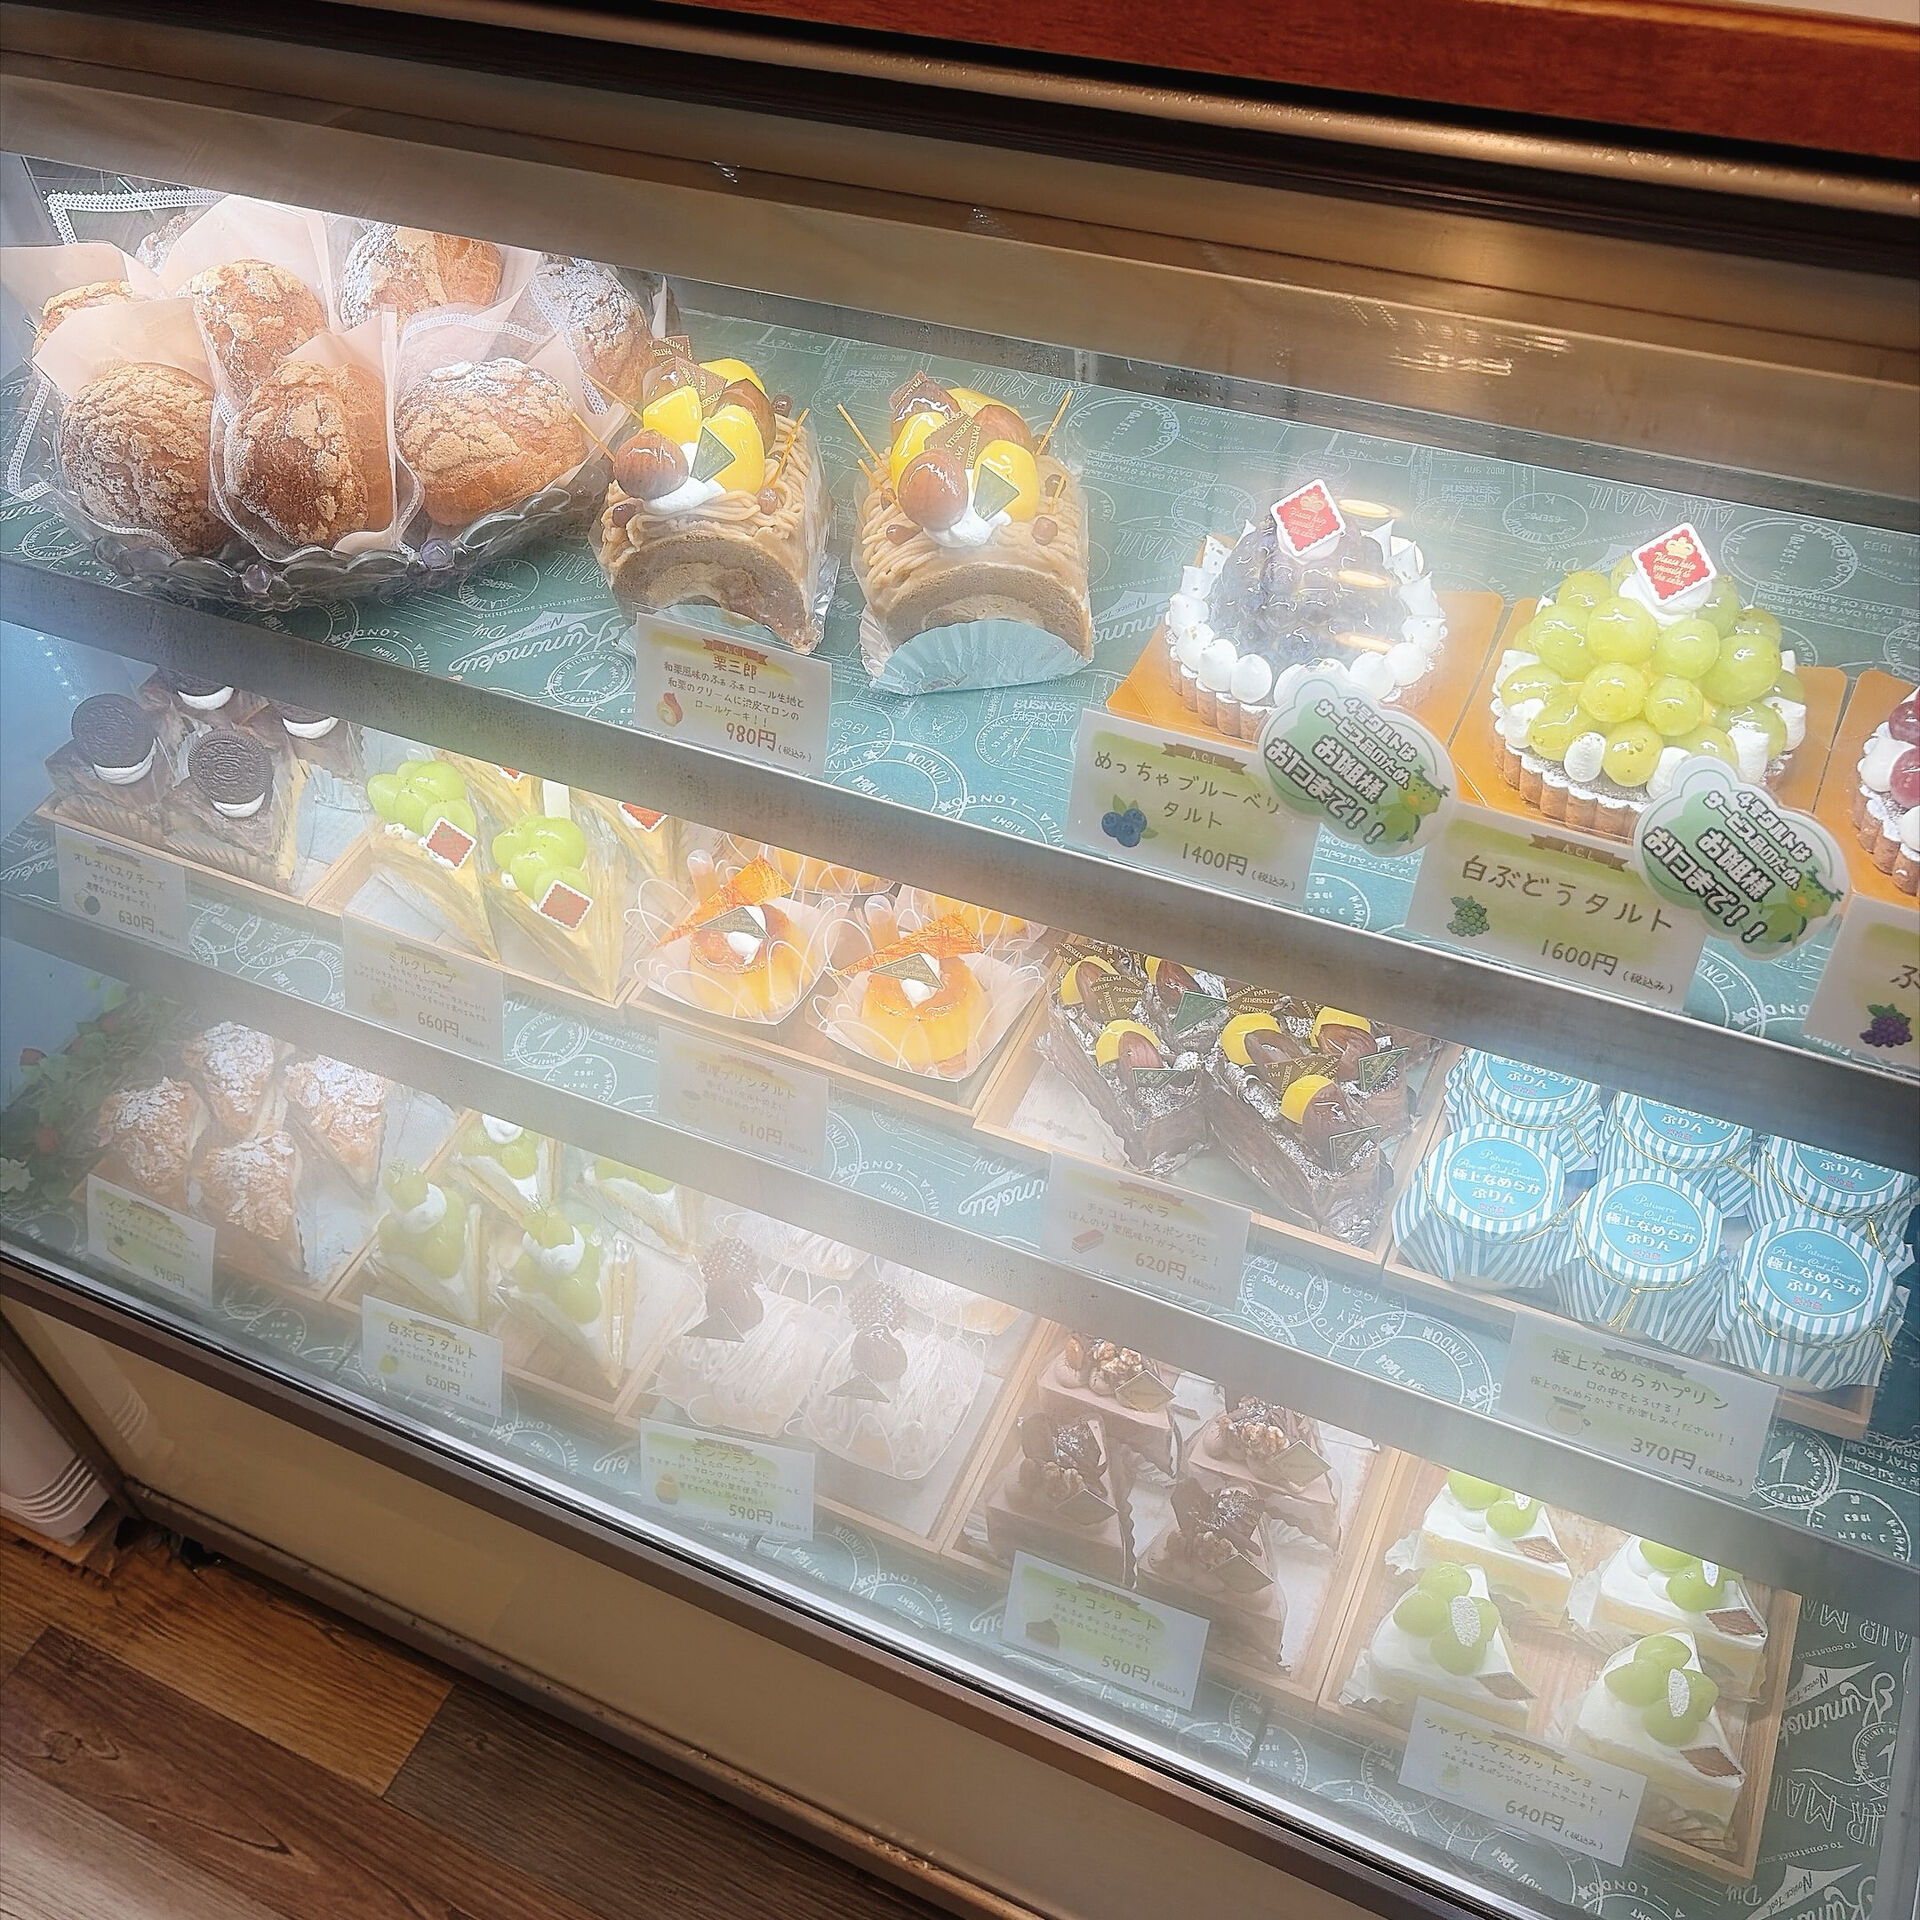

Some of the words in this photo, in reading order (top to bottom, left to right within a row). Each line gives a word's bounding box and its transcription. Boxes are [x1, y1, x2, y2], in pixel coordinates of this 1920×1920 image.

[713, 653, 758, 681] 栗三郎
[726, 722, 777, 752] 980円
[1343, 698, 1417, 762] 4号タルトは
[1163, 800, 1223, 829] タルト
[1736, 791, 1812, 862] 4号タルトは
[73, 852, 167, 891] オレオバスクチーズ
[1182, 843, 1248, 876] 1400円
[1461, 855, 1672, 932] 白ぶどうタルト
[384, 952, 457, 983] ミルクレープ
[1541, 939, 1619, 976] 1600円
[417, 1011, 460, 1038] 660円
[739, 1120, 783, 1147] 610円
[1452, 1167, 1542, 1195] 極上なめらか
[1087, 1202, 1208, 1247] チョコレートスポンジに
[1123, 1198, 1169, 1218] オペラ
[1605, 1211, 1697, 1245] 極上なめらか
[1135, 1252, 1188, 1281] 620円
[1766, 1255, 1863, 1296] 極上なめらか
[388, 1320, 478, 1360] 白ぶどうタルト
[425, 1375, 461, 1398] 620円
[1552, 1348, 1729, 1410] 極上なめらかプリン
[1586, 1379, 1681, 1416] 口の中でとろける！
[1630, 1437, 1697, 1471] 370円
[728, 1503, 774, 1525] 590円
[1055, 1584, 1162, 1632] チョコショート
[1101, 1655, 1151, 1683] 590円
[1424, 1717, 1630, 1801] シャインマスカットショート
[1505, 1799, 1565, 1833] 640円
